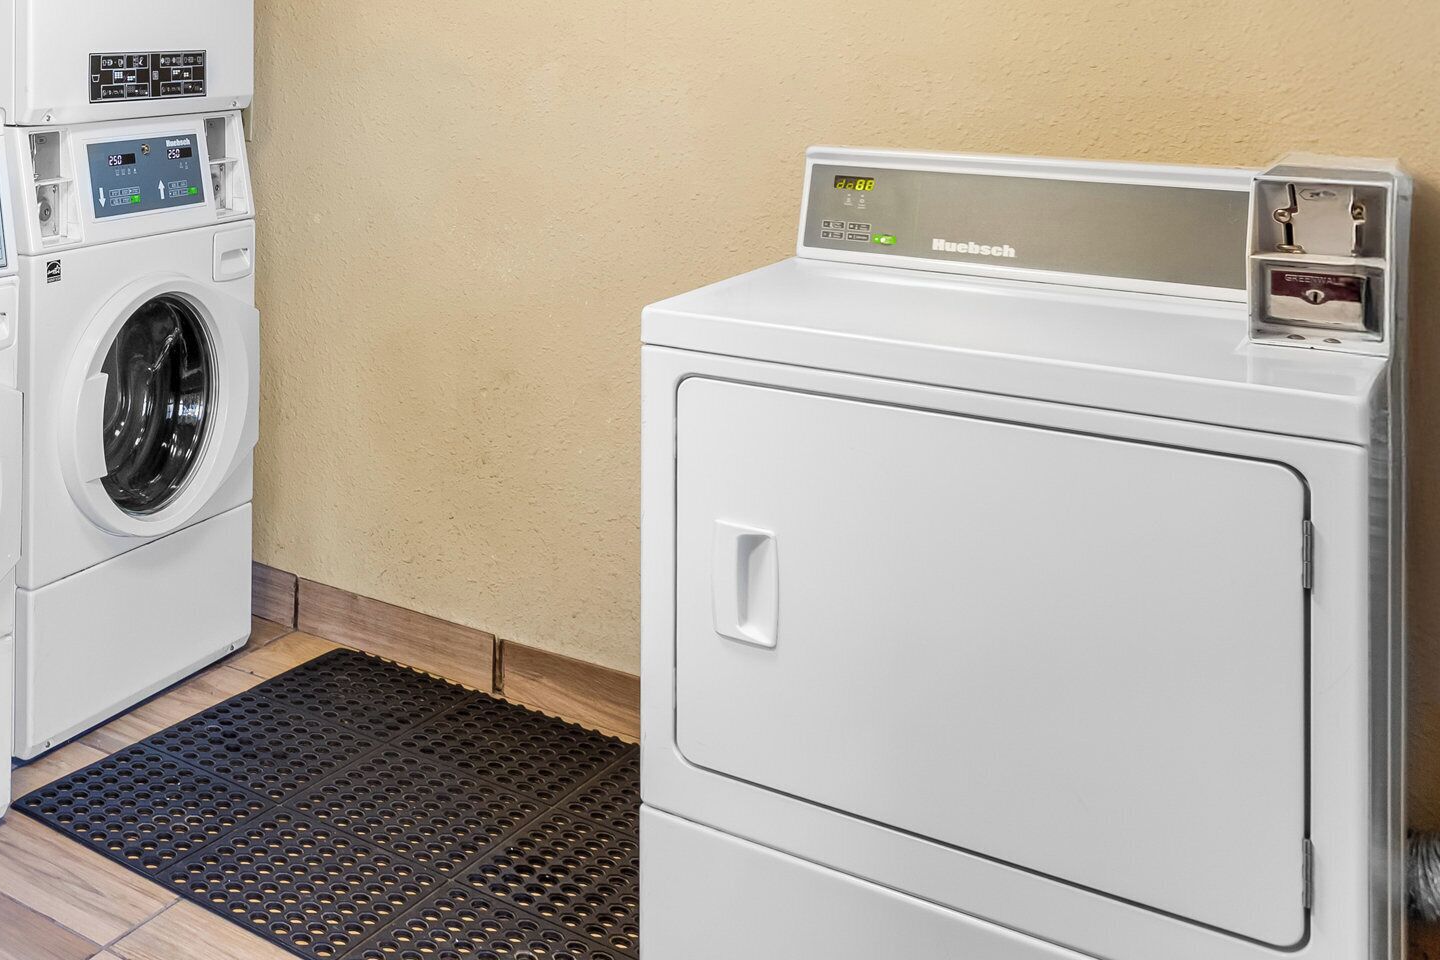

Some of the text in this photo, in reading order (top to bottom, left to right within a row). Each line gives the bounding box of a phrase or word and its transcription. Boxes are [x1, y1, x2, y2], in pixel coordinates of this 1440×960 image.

[168, 149, 180, 159] 250
[109, 155, 122, 166] 250
[931, 238, 1016, 258] Huebsch
